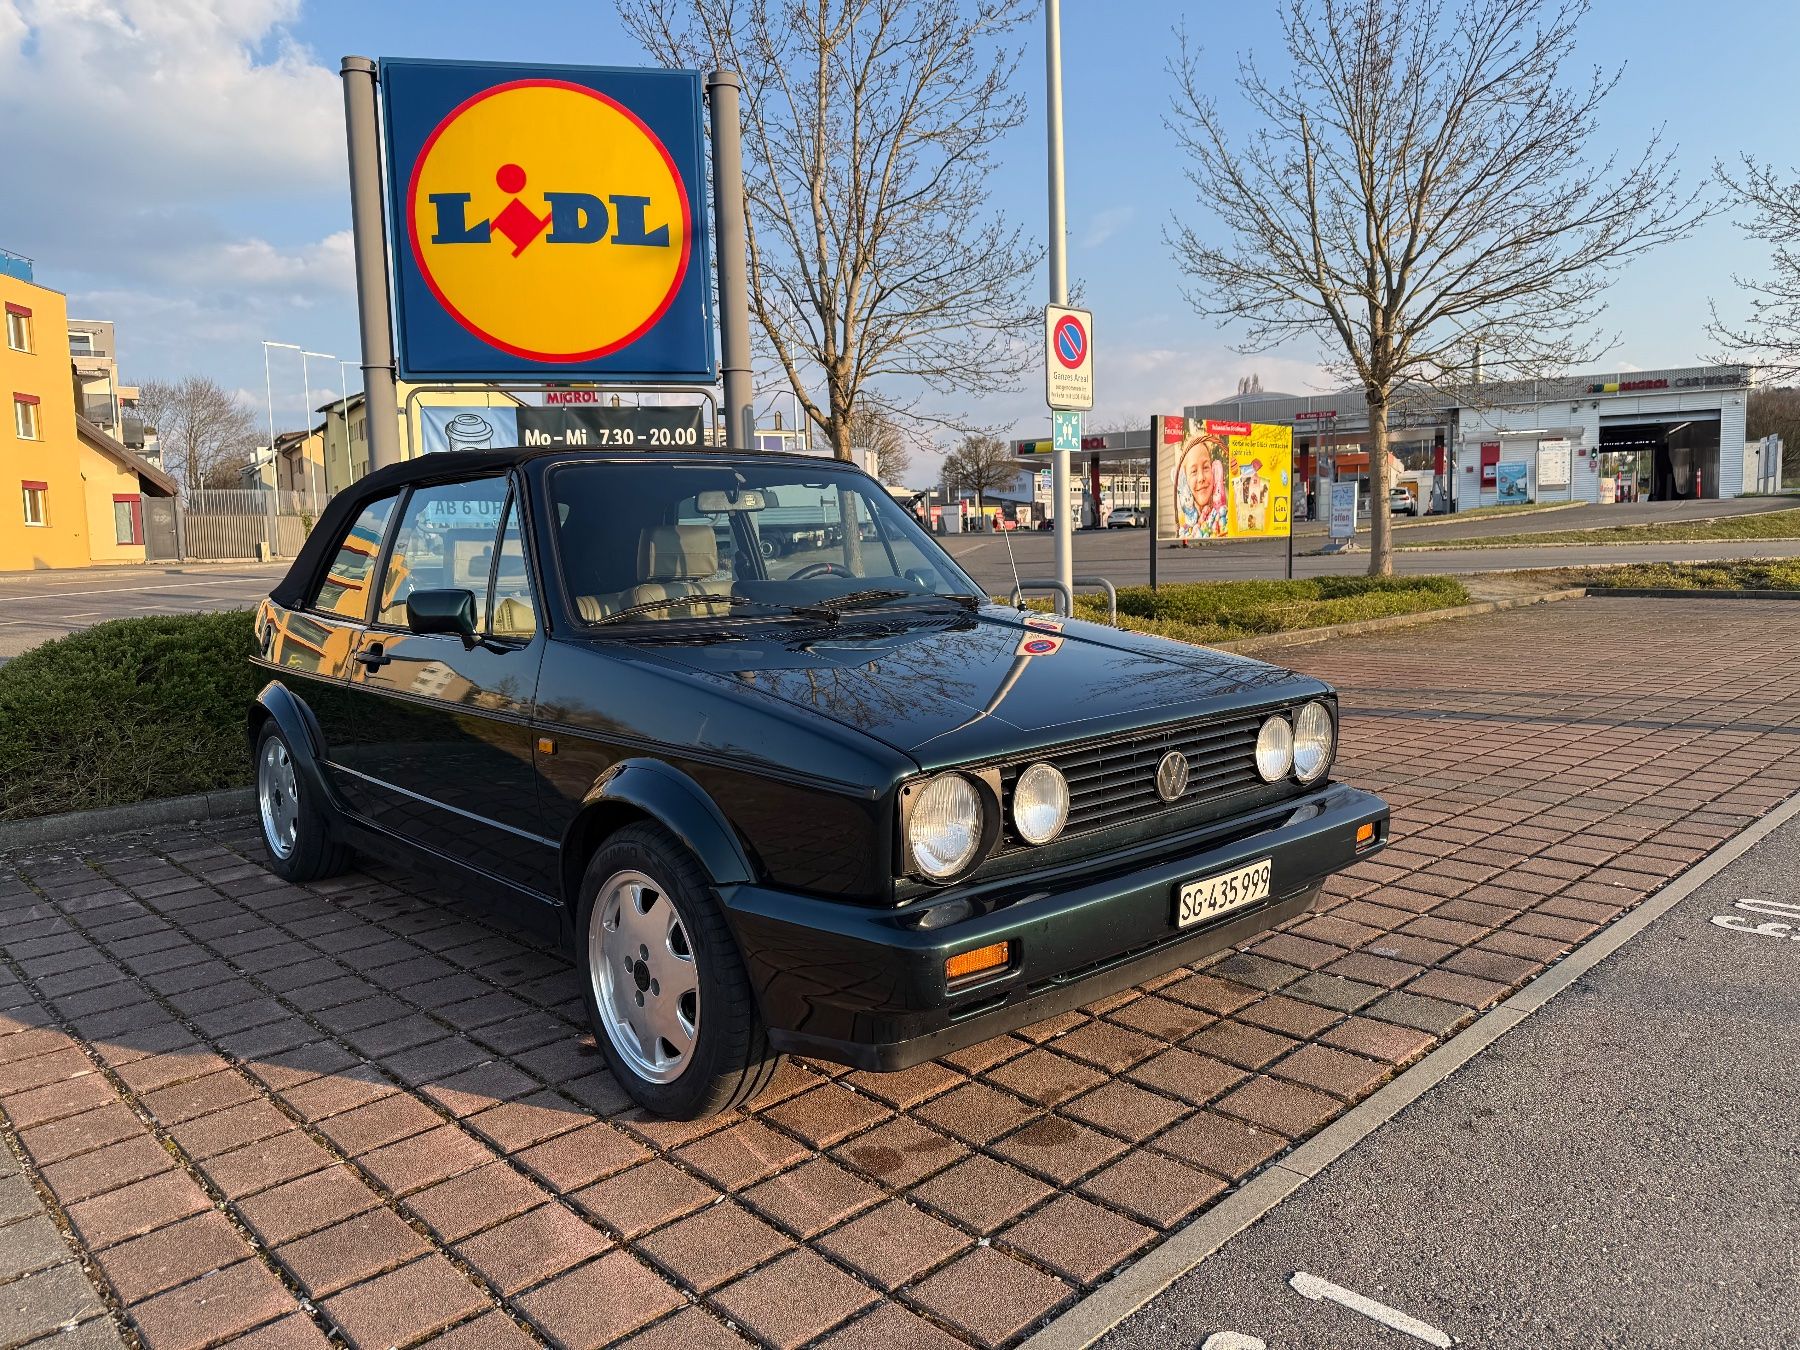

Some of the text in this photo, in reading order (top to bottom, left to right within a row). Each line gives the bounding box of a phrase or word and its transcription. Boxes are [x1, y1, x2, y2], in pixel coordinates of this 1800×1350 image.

[1619, 378, 1670, 392] MIGROL
[546, 391, 599, 404] MIGROL
[1081, 437, 1107, 451] ROL
[435, 501, 457, 515] AB
[462, 501, 472, 515] 6
